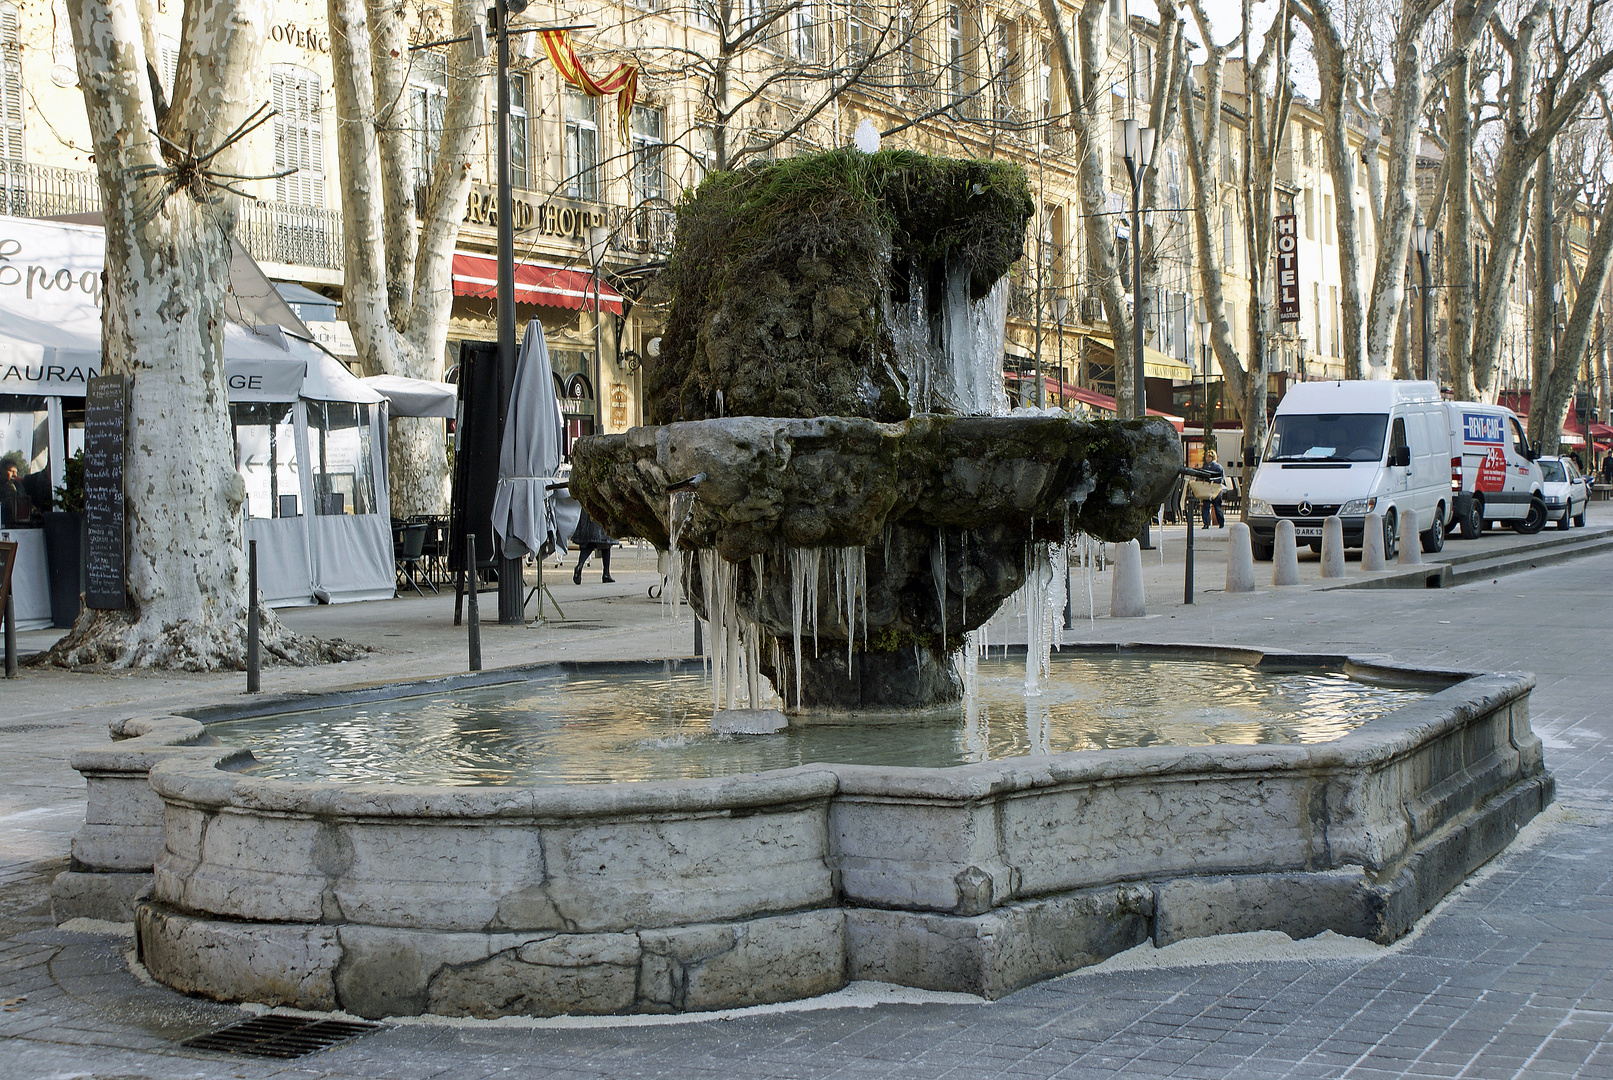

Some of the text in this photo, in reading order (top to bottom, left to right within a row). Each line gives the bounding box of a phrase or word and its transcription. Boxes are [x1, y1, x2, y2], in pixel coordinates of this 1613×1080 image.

[267, 22, 329, 53] OVENC
[1279, 218, 1296, 304] HOTEL
[1468, 416, 1484, 438] RENT
[1486, 418, 1500, 439] CAR
